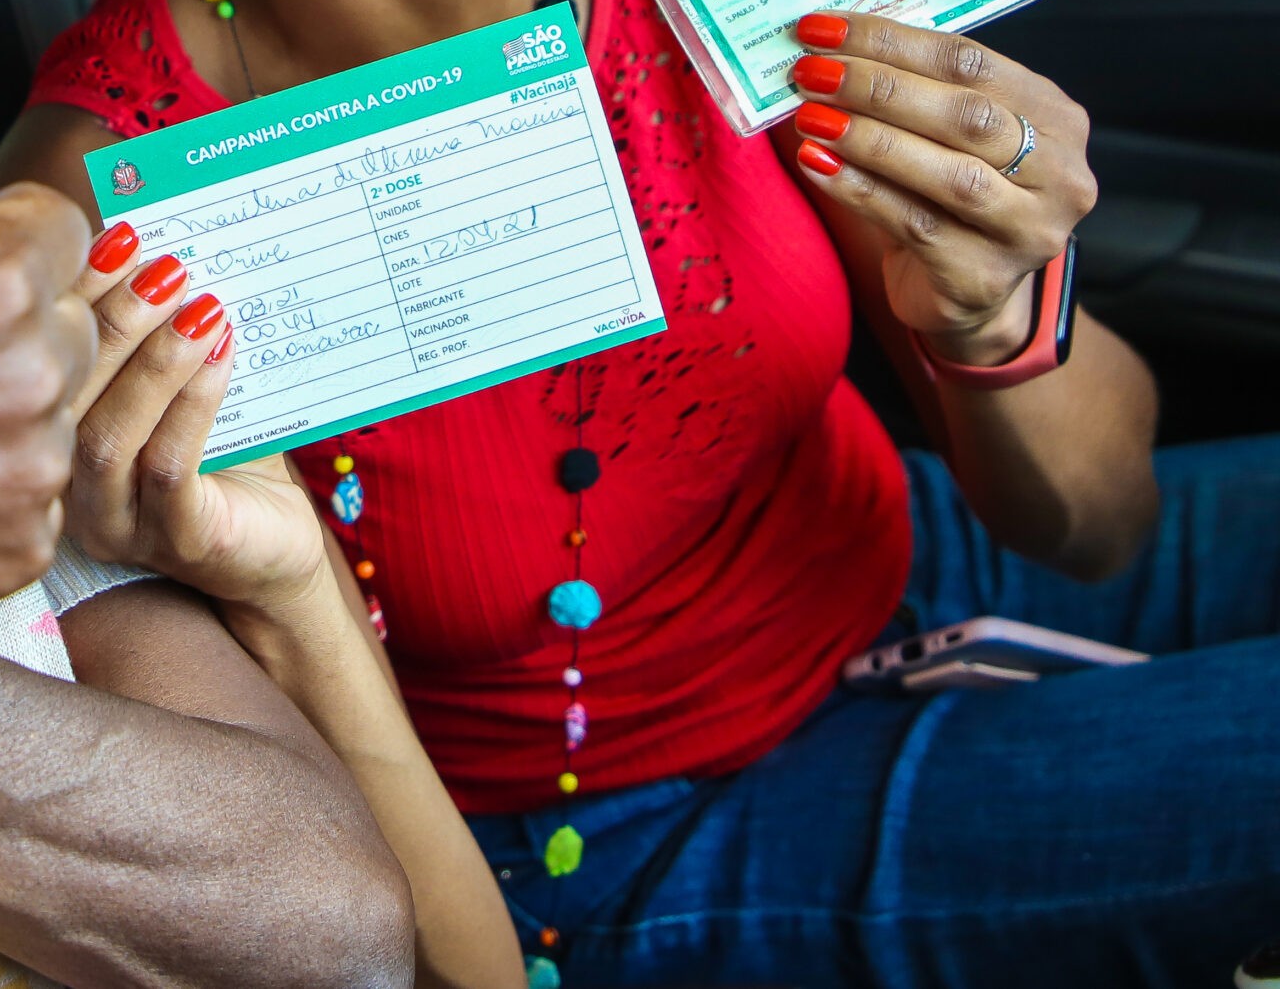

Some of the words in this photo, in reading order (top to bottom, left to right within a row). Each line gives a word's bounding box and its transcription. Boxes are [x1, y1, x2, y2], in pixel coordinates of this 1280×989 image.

[725, 4, 755, 24] S.PAULO
[521, 24, 562, 48] SÃO
[742, 31, 775, 51] BARUERI
[773, 26, 783, 35] SP
[506, 39, 567, 71] PAULO
[509, 63, 538, 76] GOVERNO
[537, 59, 547, 68] DO
[546, 53, 569, 66] ESTADO
[509, 74, 577, 105] #Vacinajá
[186, 120, 290, 166] CAMPANHA
[291, 96, 365, 132] CONTRA
[366, 94, 381, 110] A
[381, 66, 463, 101] COVID-19
[385, 173, 423, 195] DOSE
[375, 199, 422, 221] UNIDADE
[140, 226, 166, 242] OME
[383, 229, 410, 245] CNES
[391, 256, 420, 273] DATA:
[397, 277, 423, 293] LOTE
[404, 289, 465, 315] FABRICANTE
[410, 313, 470, 339] VACINADOR
[594, 311, 646, 335] VACIVIDA
[417, 348, 441, 363] REG.
[442, 341, 470, 356] PROF.
[215, 410, 245, 425] PROF.
[253, 433, 265, 443] DE
[265, 418, 309, 439] VACINAÇÃO
